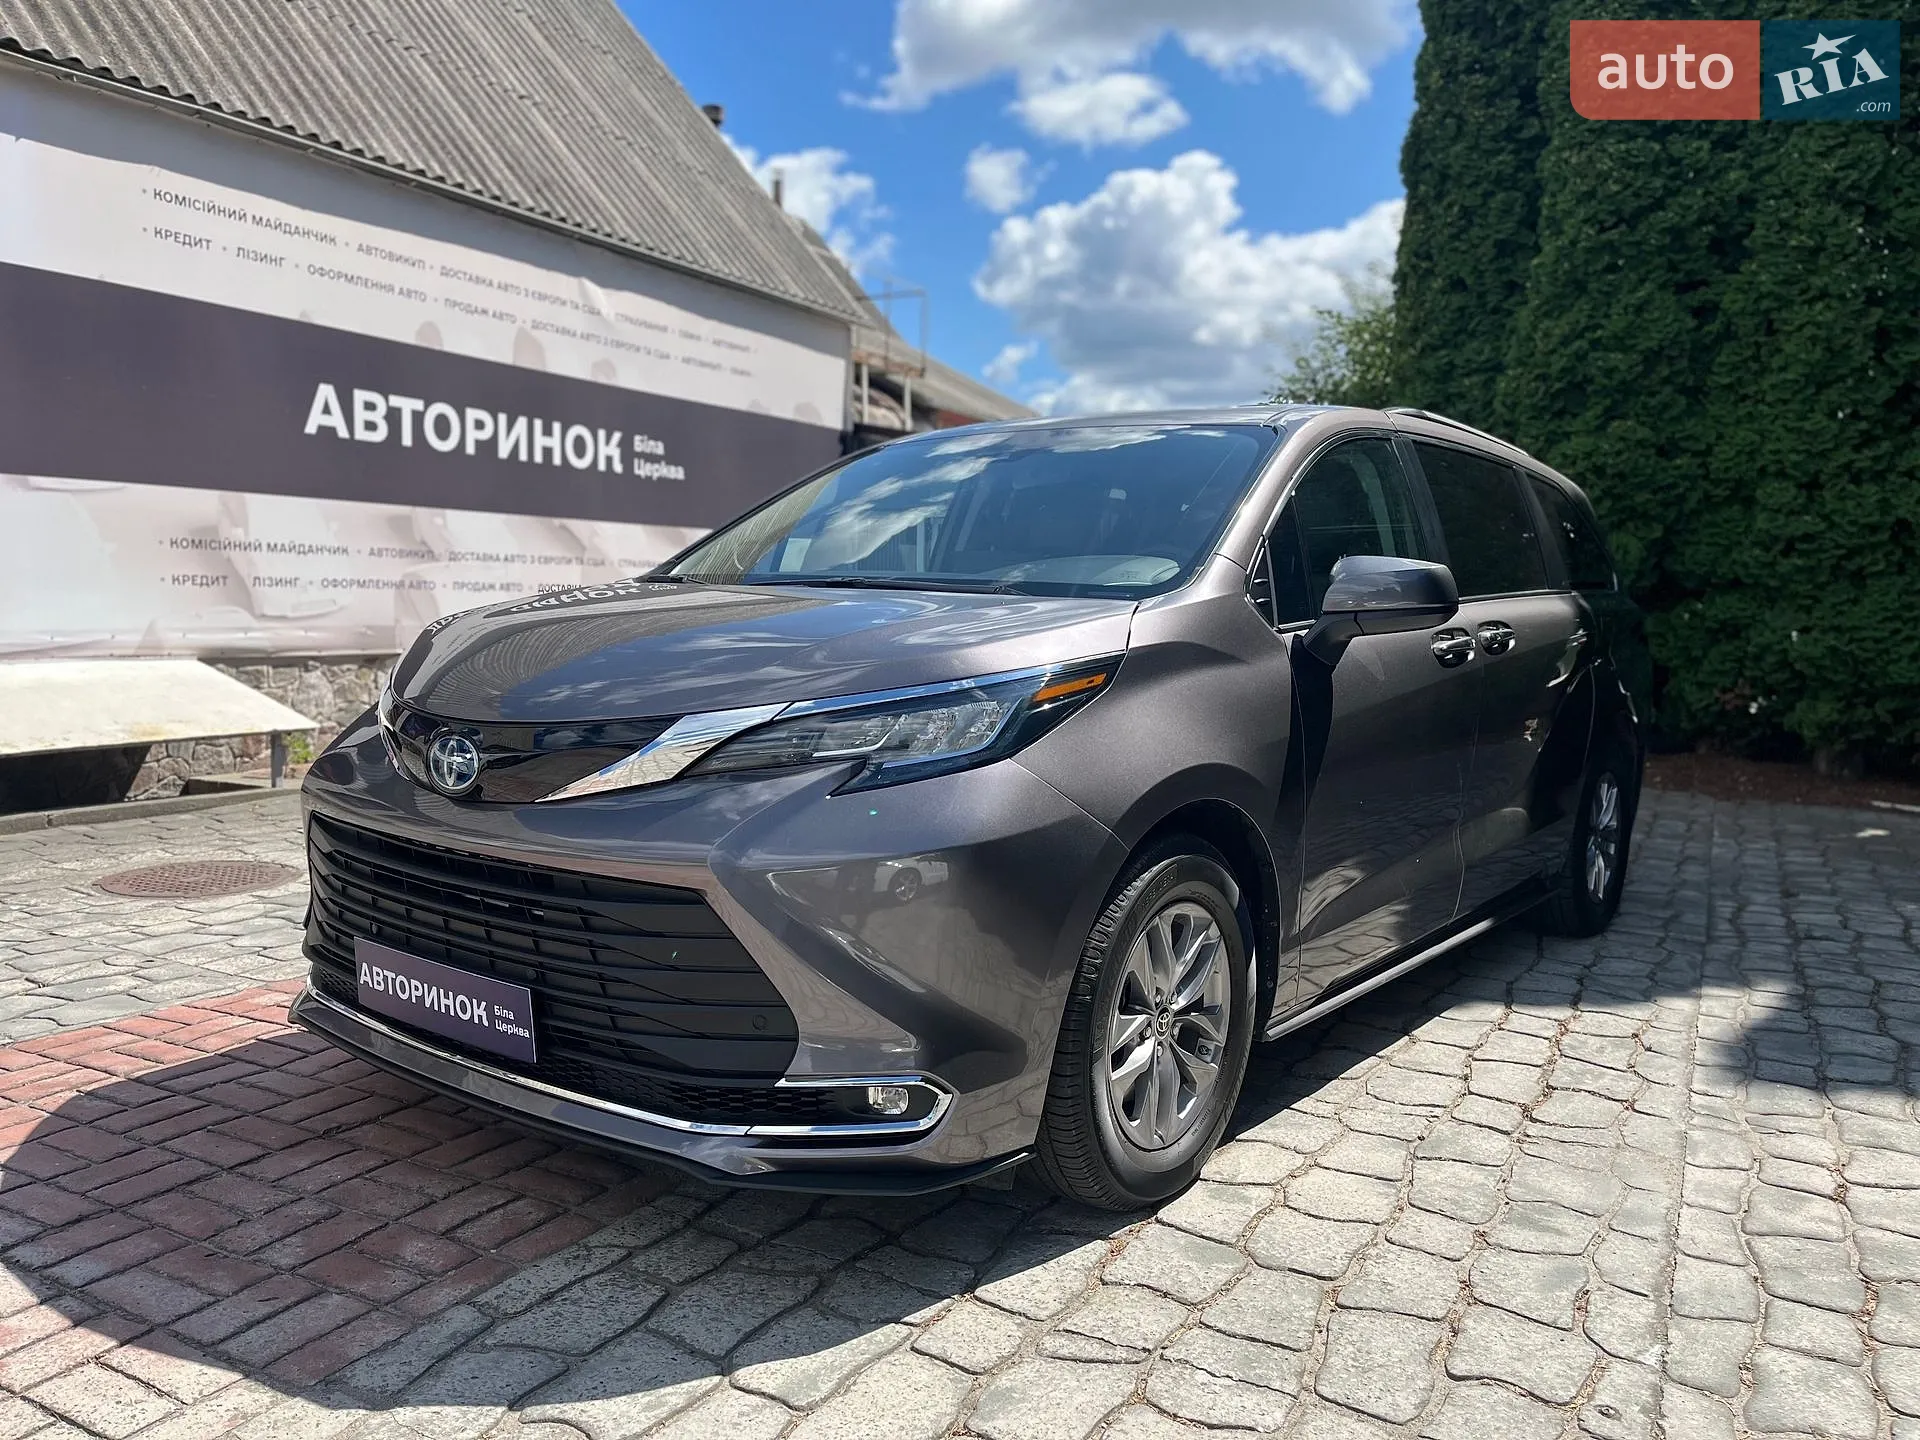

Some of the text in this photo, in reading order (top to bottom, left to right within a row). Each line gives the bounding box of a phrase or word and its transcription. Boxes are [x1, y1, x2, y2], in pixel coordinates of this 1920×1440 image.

[153, 187, 247, 224] КОМІСІЙНИЙ
[251, 213, 337, 248] МАЙДАНЧИК
[356, 242, 426, 270] АВТОВИКУП
[439, 264, 494, 288] ДОСТАВКА
[153, 226, 212, 252] КРЕДИТ
[236, 245, 286, 270] ЛІЗИНГ
[307, 263, 395, 294] ОФОРМЛЕННЯ
[397, 284, 428, 303] АВТО
[444, 298, 489, 317] ПРОДАЖ
[304, 382, 665, 474] АВТОРИНОК Біла
[633, 458, 685, 481] Церква
[169, 537, 263, 553] КОМІСІЙНИЙ
[266, 540, 349, 557] МАЙДАНЧИК
[448, 549, 500, 563] ДОСТАВКА
[171, 574, 229, 588] КРЕДИТ
[252, 575, 301, 589] ЛІЗИНГ
[321, 577, 405, 590] ОФОРМЛЕННЯ
[407, 579, 437, 591] АВТО
[452, 580, 496, 593] ПРОДАЖ
[359, 962, 515, 1027] АВТОРИНОК Біла
[495, 1019, 530, 1039] Церква
